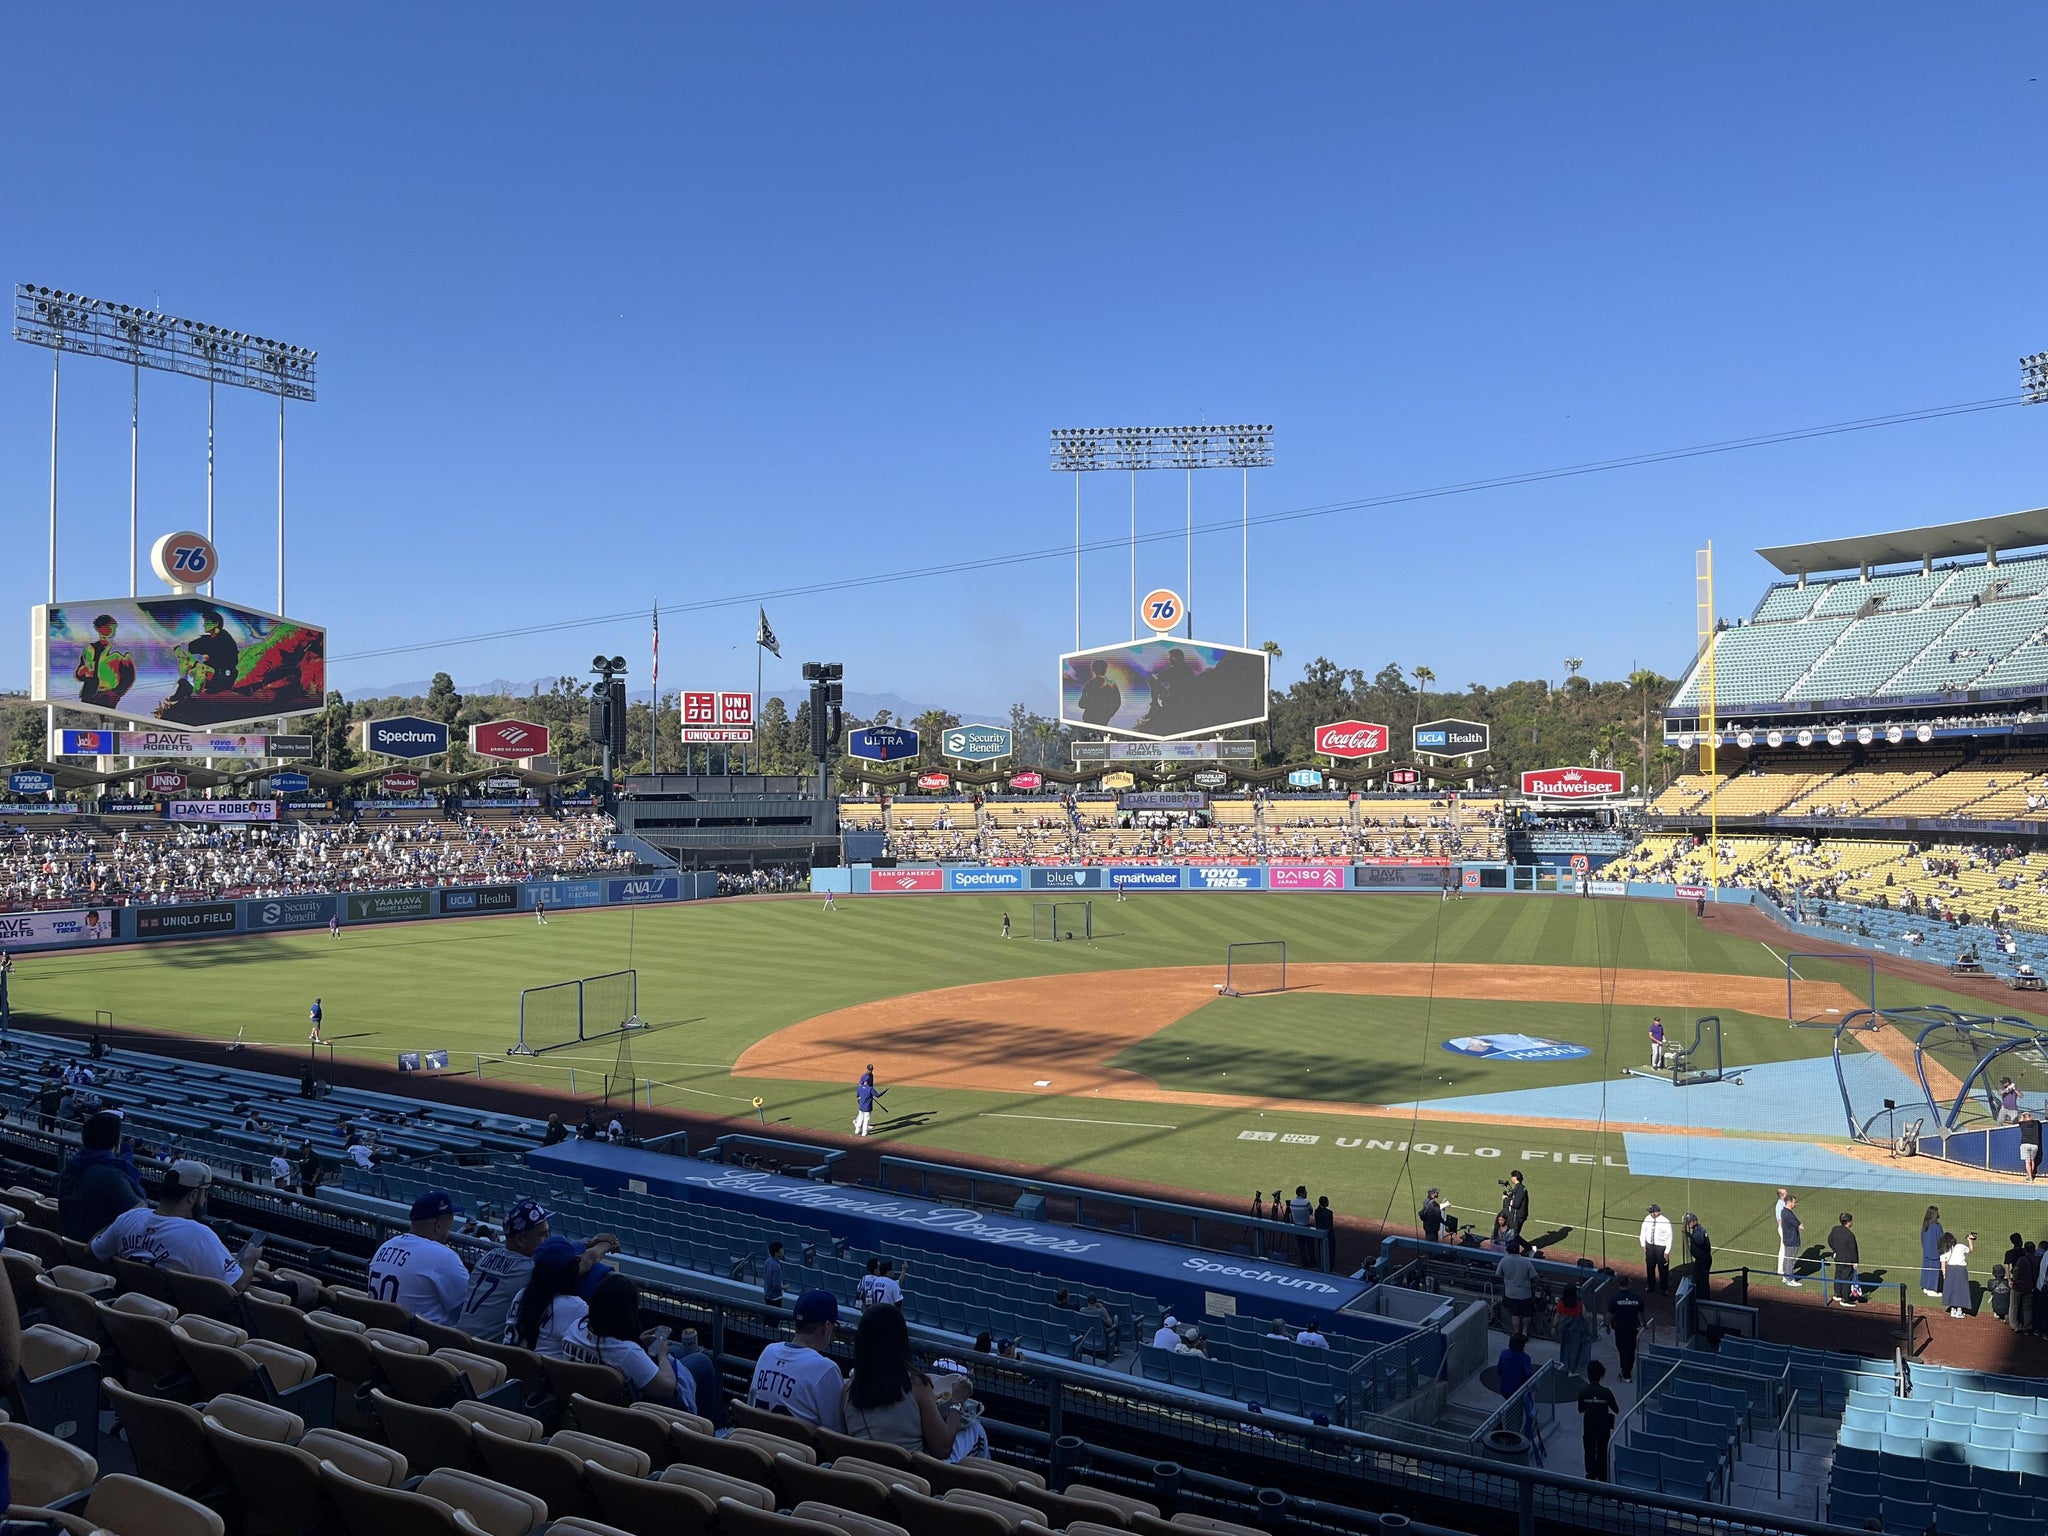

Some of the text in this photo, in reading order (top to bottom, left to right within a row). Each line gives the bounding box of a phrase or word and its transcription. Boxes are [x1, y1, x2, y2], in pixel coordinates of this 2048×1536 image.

[172, 547, 208, 572] 76
[1151, 600, 1174, 619] 76
[1997, 684, 2048, 697] DAVE ROBERT
[688, 696, 711, 706] ユニ
[725, 697, 747, 707] UNI
[1843, 696, 1903, 708] DAVE ROBERTS
[688, 710, 711, 719] クロ
[725, 709, 748, 721] QLO
[146, 733, 190, 744] DAVE
[378, 730, 436, 744] Spectrum
[687, 732, 749, 741] UNIQLO FIELD
[969, 733, 1005, 745] Security
[1322, 729, 1381, 749] Coca-Cola
[1419, 733, 1483, 743] UCLA Health
[969, 743, 1001, 752] Benefit
[1128, 743, 1160, 751] DAVE
[151, 775, 181, 789] JINRO
[385, 778, 416, 786] Yakult
[919, 776, 947, 786] Churu
[1292, 772, 1318, 783] TEL
[18, 782, 48, 790] TIRES
[1532, 779, 1612, 793] Budweiser
[1127, 795, 1200, 803] DAVE ROBETS
[176, 803, 271, 814] DAVE ROBETS
[1935, 820, 1988, 829] DAVE ROBERTS
[1573, 857, 1586, 867] 76
[1047, 872, 1074, 882] blue
[1113, 873, 1176, 884] smartwater
[1199, 868, 1238, 879] TOYO
[1277, 870, 1320, 879] DAISO
[1371, 869, 1404, 877] DAVE
[1465, 874, 1478, 883] 76
[955, 873, 1014, 886] Spectrum
[1205, 878, 1248, 887] TIRES
[623, 881, 650, 894] ANA
[450, 893, 511, 905] UCLA Health
[528, 887, 562, 904] TEL
[567, 891, 599, 899] ELECTRON
[284, 901, 322, 912] Security
[162, 914, 200, 927] UNIQLO
[203, 912, 232, 924] FIELD
[285, 912, 317, 923] Benefit
[0, 918, 31, 931] AVE
[52, 920, 76, 928] TOYO
[0, 930, 34, 939] ERTS
[56, 926, 82, 934] TIRES
[1335, 1137, 1629, 1168] UNIQLO FIEL
[686, 1167, 1102, 1254] Los Angeles Dodgers
[121, 1234, 169, 1264] BUEHLER
[377, 1247, 411, 1267] BETTS
[480, 1255, 516, 1274] OHTANI
[1182, 1258, 1330, 1294] Spectrum
[465, 1271, 500, 1315] 17
[757, 1369, 796, 1398] BETTS
